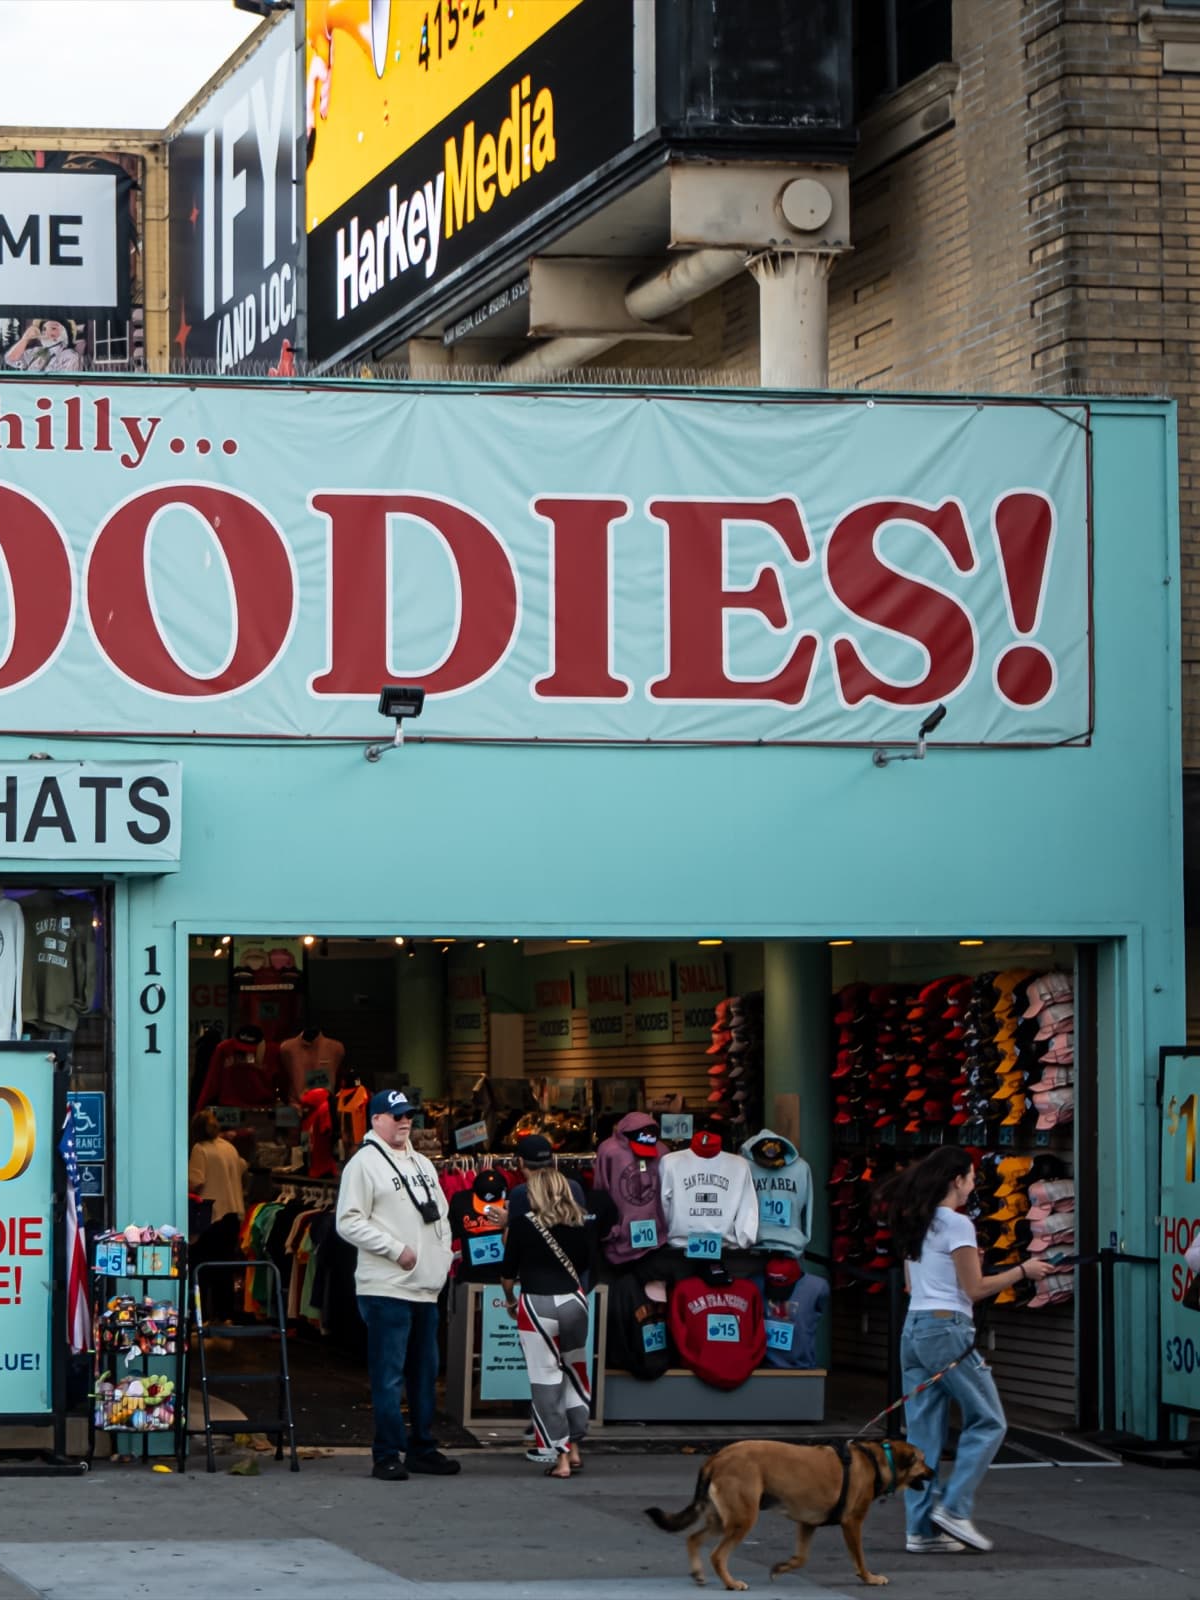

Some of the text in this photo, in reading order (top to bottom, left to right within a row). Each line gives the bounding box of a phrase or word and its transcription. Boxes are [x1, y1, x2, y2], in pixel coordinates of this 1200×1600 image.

[204, 46, 296, 320] IFY
[335, 74, 556, 320] HarkeyMedia
[139, 944, 167, 1055] 101
